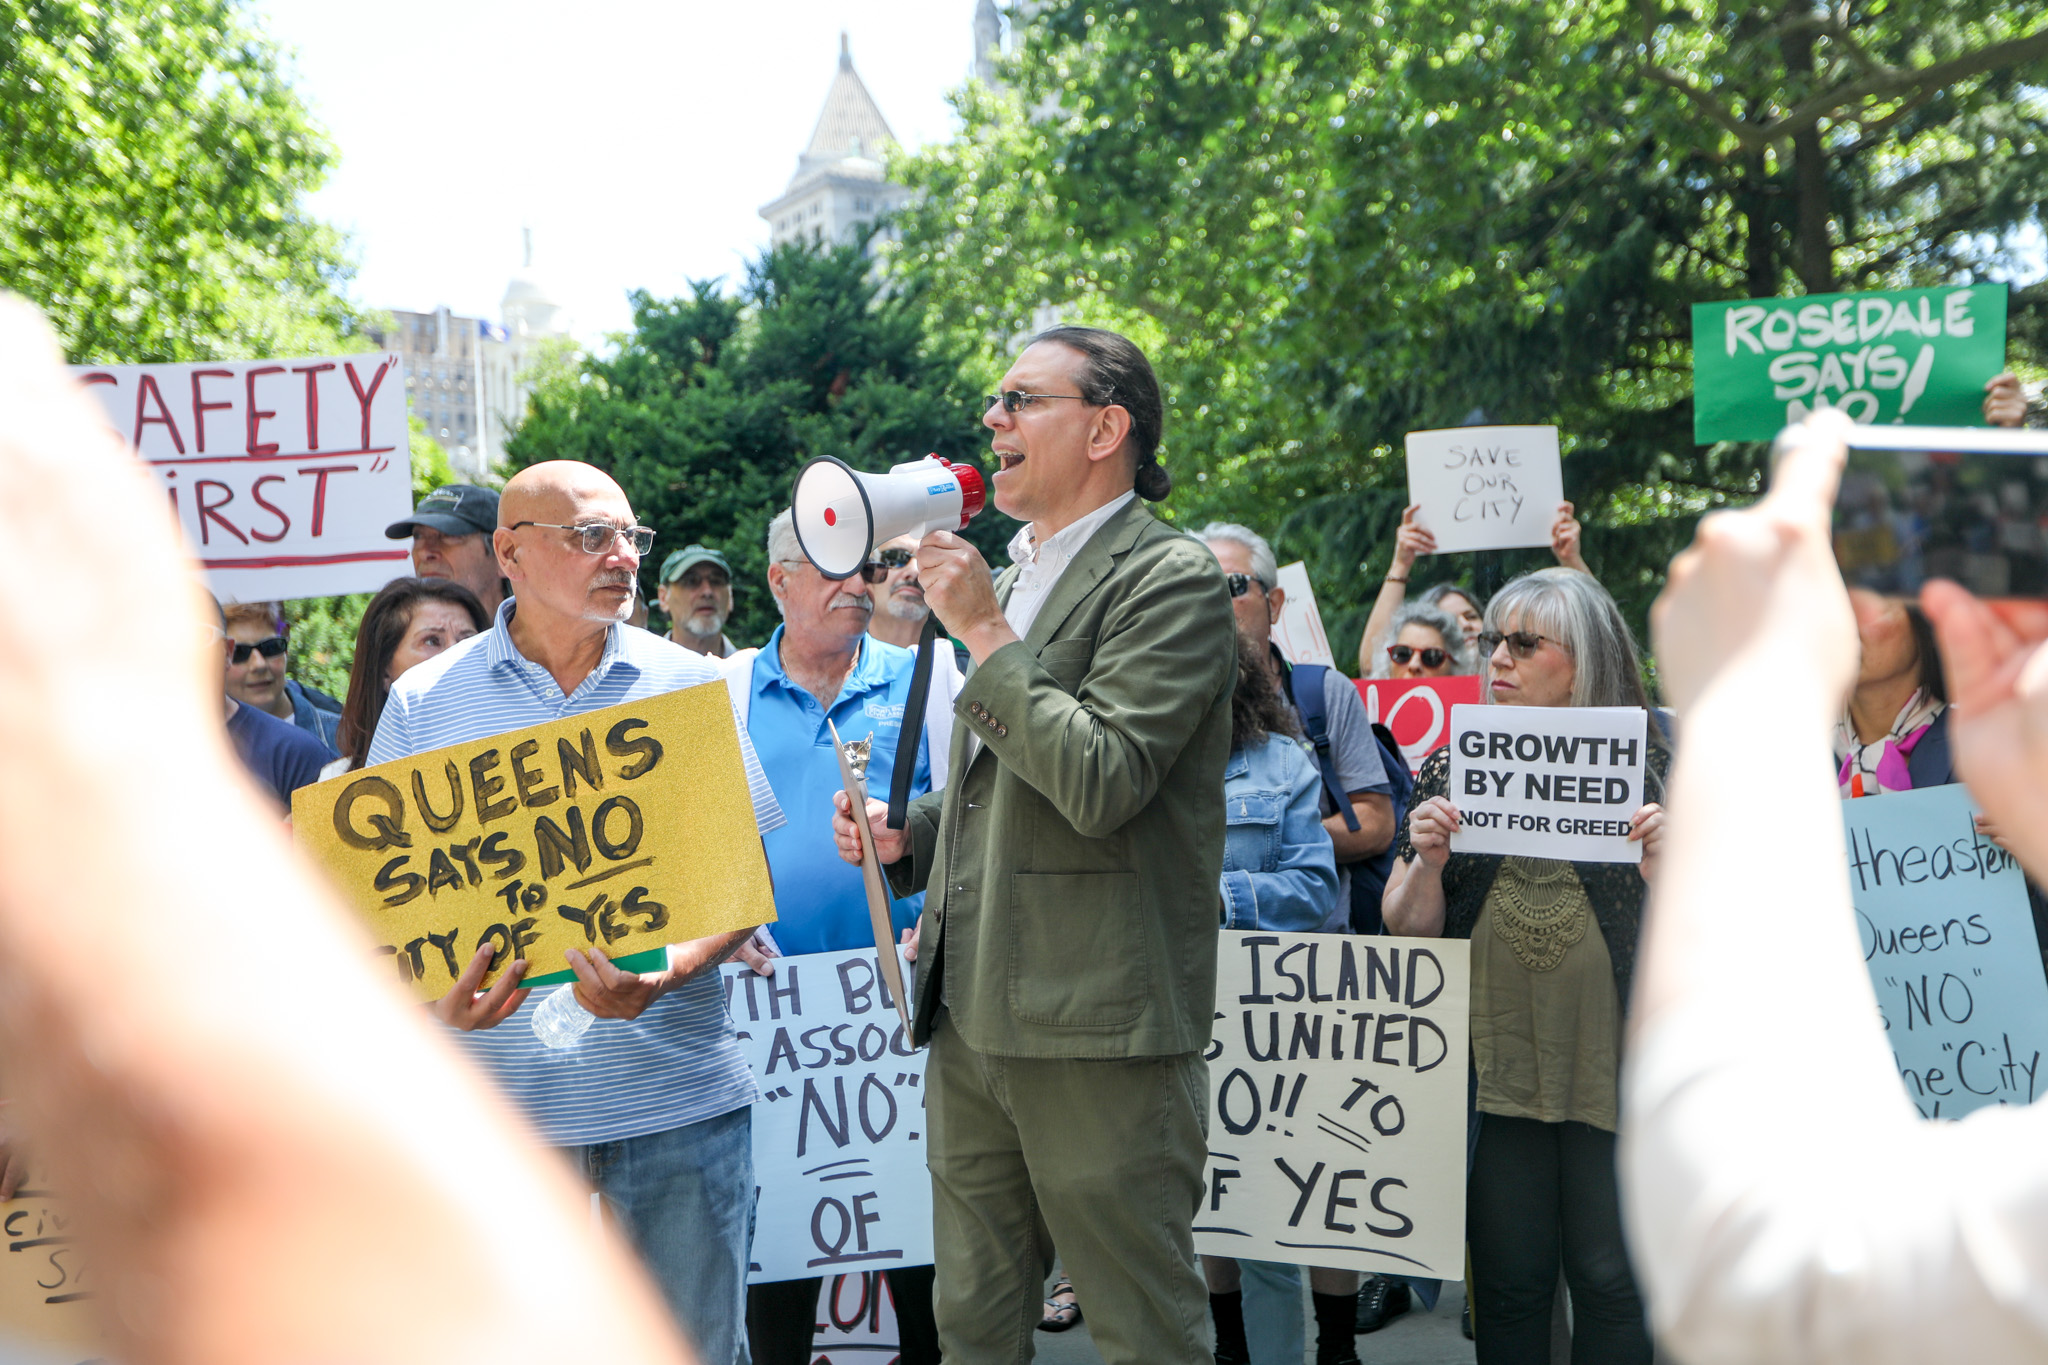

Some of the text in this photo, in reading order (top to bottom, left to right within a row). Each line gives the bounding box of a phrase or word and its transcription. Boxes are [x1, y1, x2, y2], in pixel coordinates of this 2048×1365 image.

[1725, 289, 1975, 357] ROSEDALE
[83, 355, 398, 455] AFETY"
[1444, 445, 1522, 469] SAVE
[1463, 472, 1518, 495] OUR
[1453, 495, 1524, 525] CITY
[1458, 730, 1638, 767] GROWTH
[333, 718, 664, 851] QUEENS
[1464, 768, 1630, 805] BY NEED
[372, 795, 644, 910] SAYS NO
[1459, 809, 1633, 837] NOT FOR GREED
[496, 879, 548, 915] TO
[476, 917, 544, 972] OF
[557, 886, 670, 945] YES
[1239, 936, 1445, 1010] ISLAND
[1340, 1077, 1406, 1136] TO
[810, 1191, 881, 1256] OF
[1203, 1156, 1414, 1239] F YES
